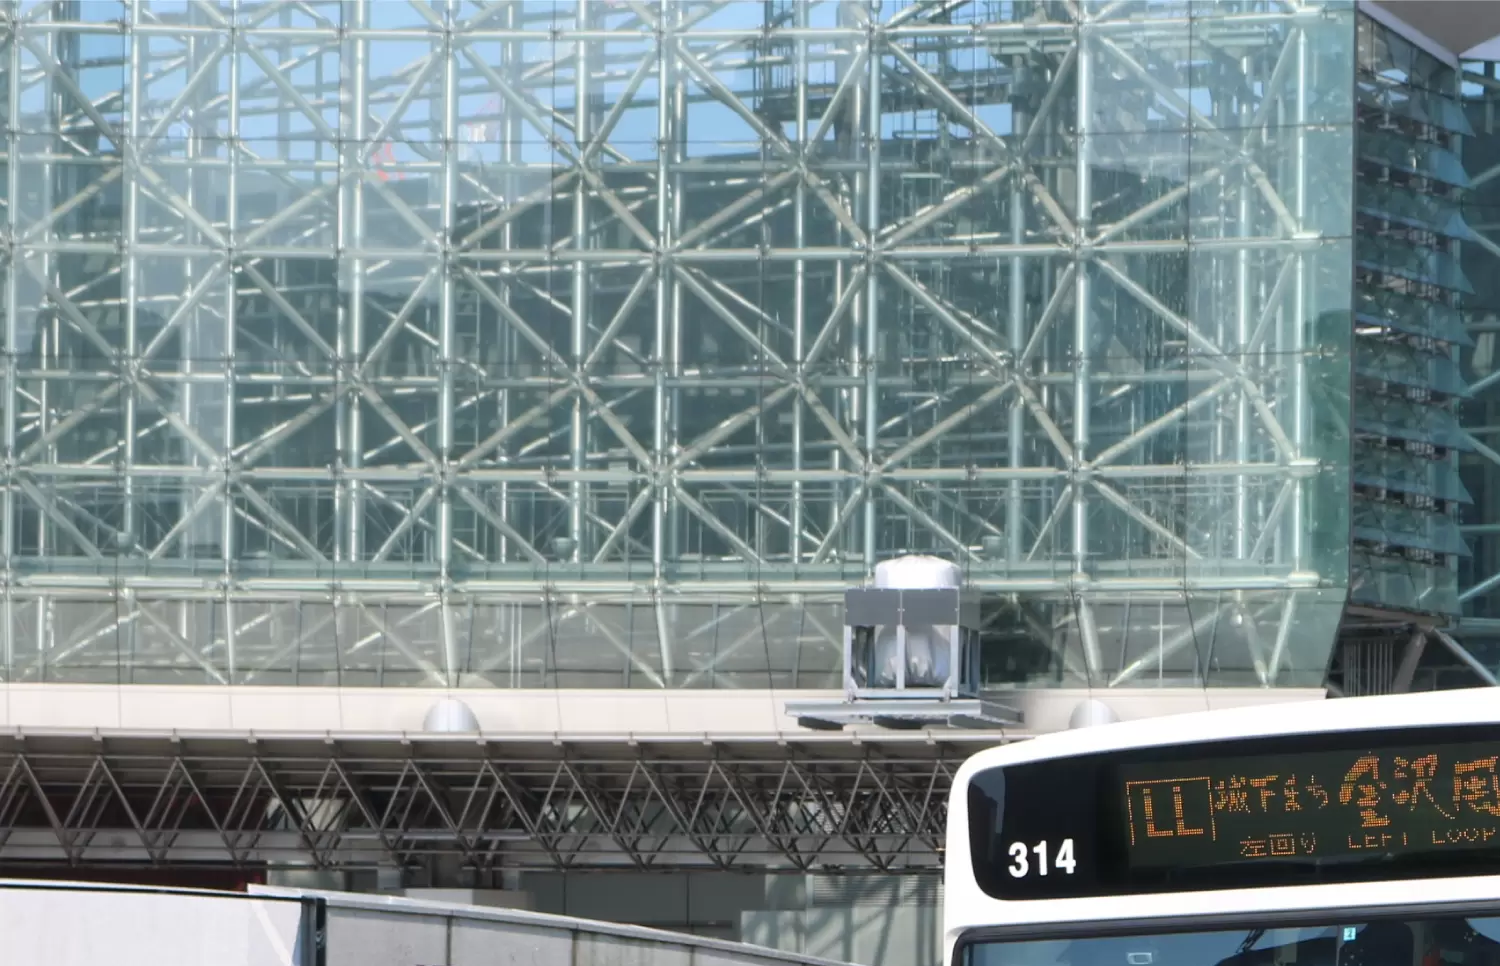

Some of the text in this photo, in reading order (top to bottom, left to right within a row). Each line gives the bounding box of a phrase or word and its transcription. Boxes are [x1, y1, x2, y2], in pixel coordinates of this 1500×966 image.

[1142, 786, 1204, 837] LL
[1008, 838, 1076, 878] 314
[1240, 832, 1317, 858] 左回り
